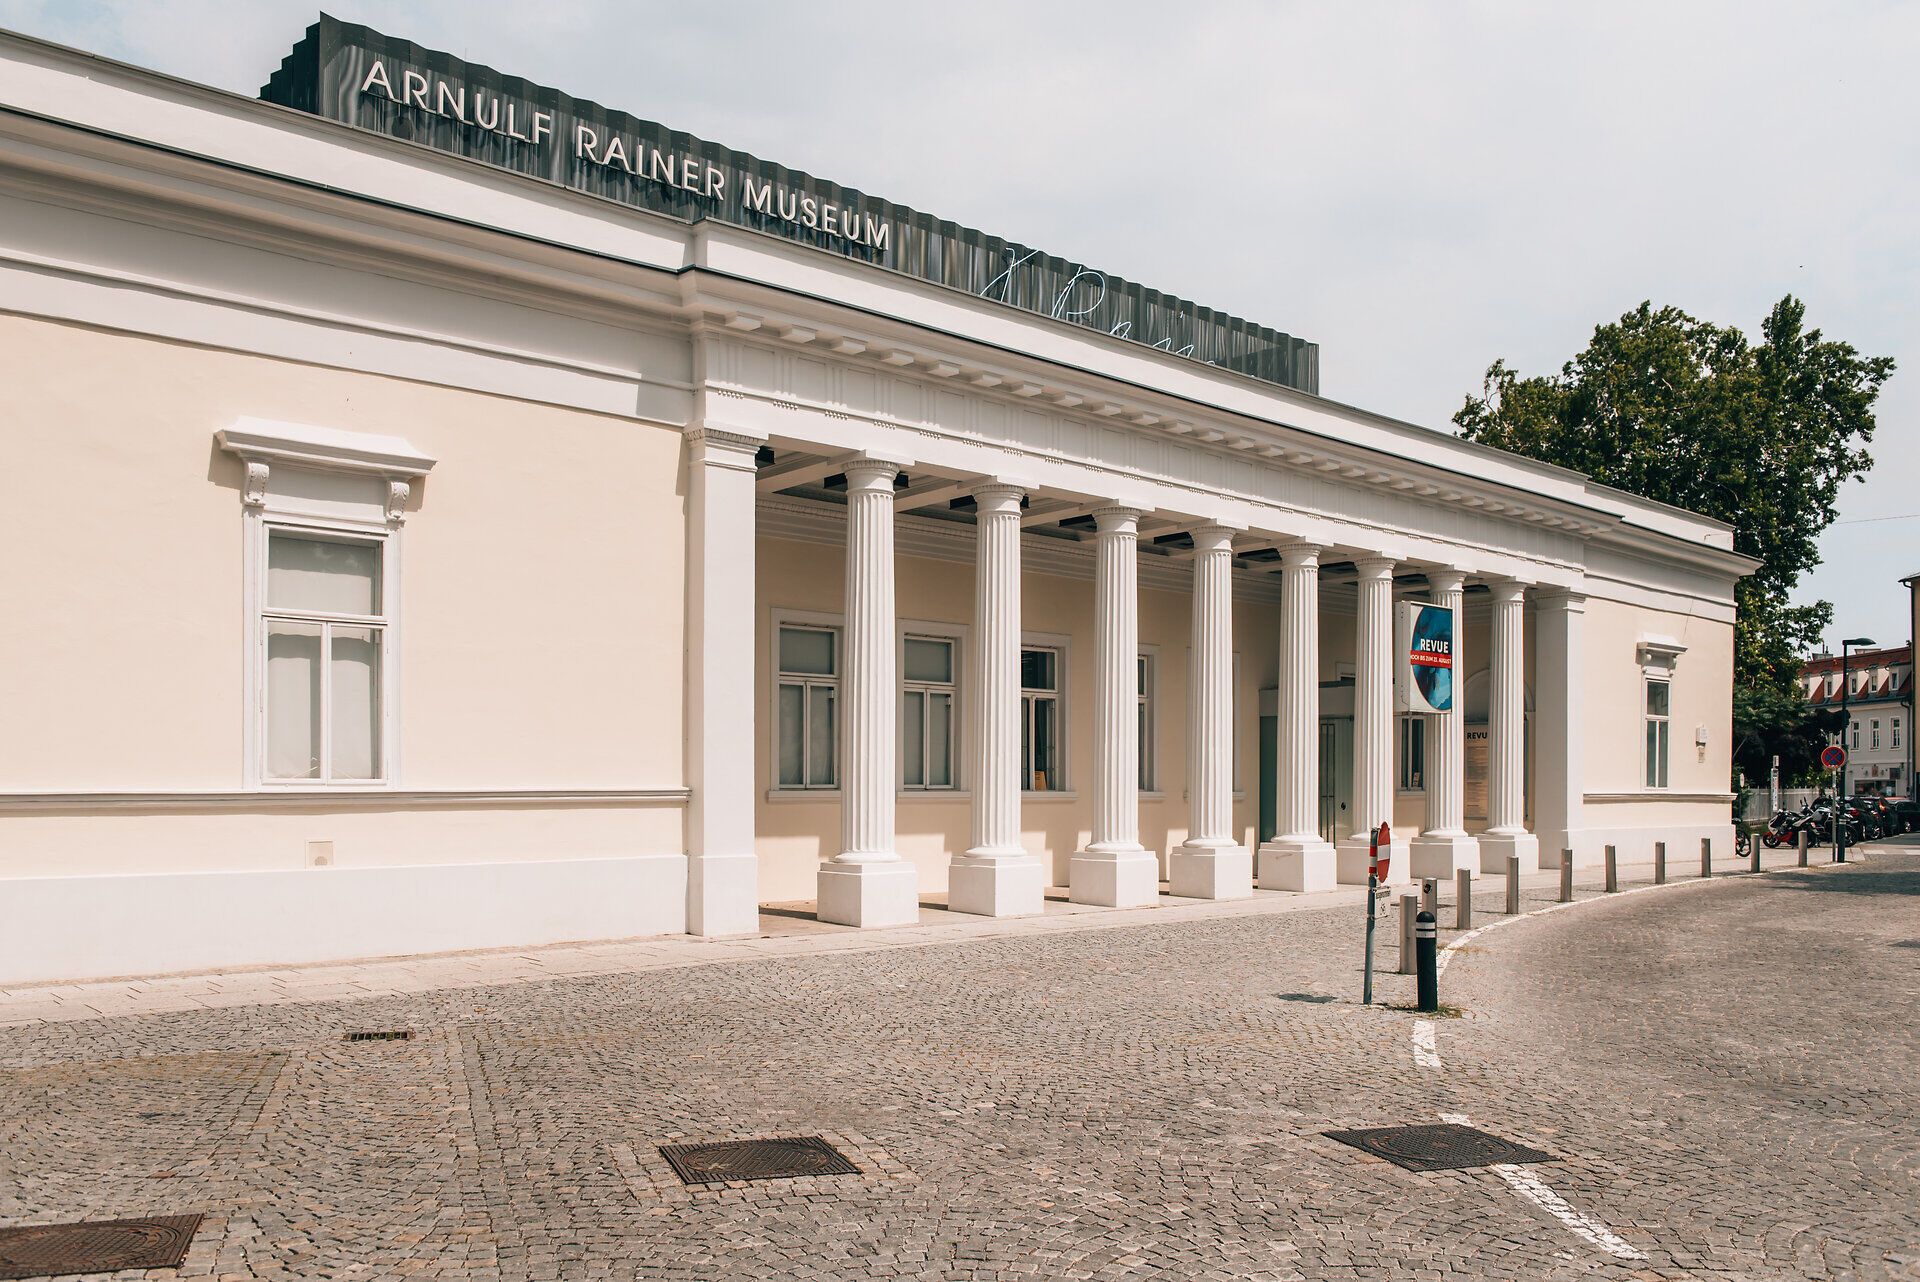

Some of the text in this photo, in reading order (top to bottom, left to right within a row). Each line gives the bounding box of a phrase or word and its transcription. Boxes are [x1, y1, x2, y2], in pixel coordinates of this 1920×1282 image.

[361, 60, 889, 250] ARNULF RAINER MUSEUM
[1420, 638, 1449, 653] REVUE
